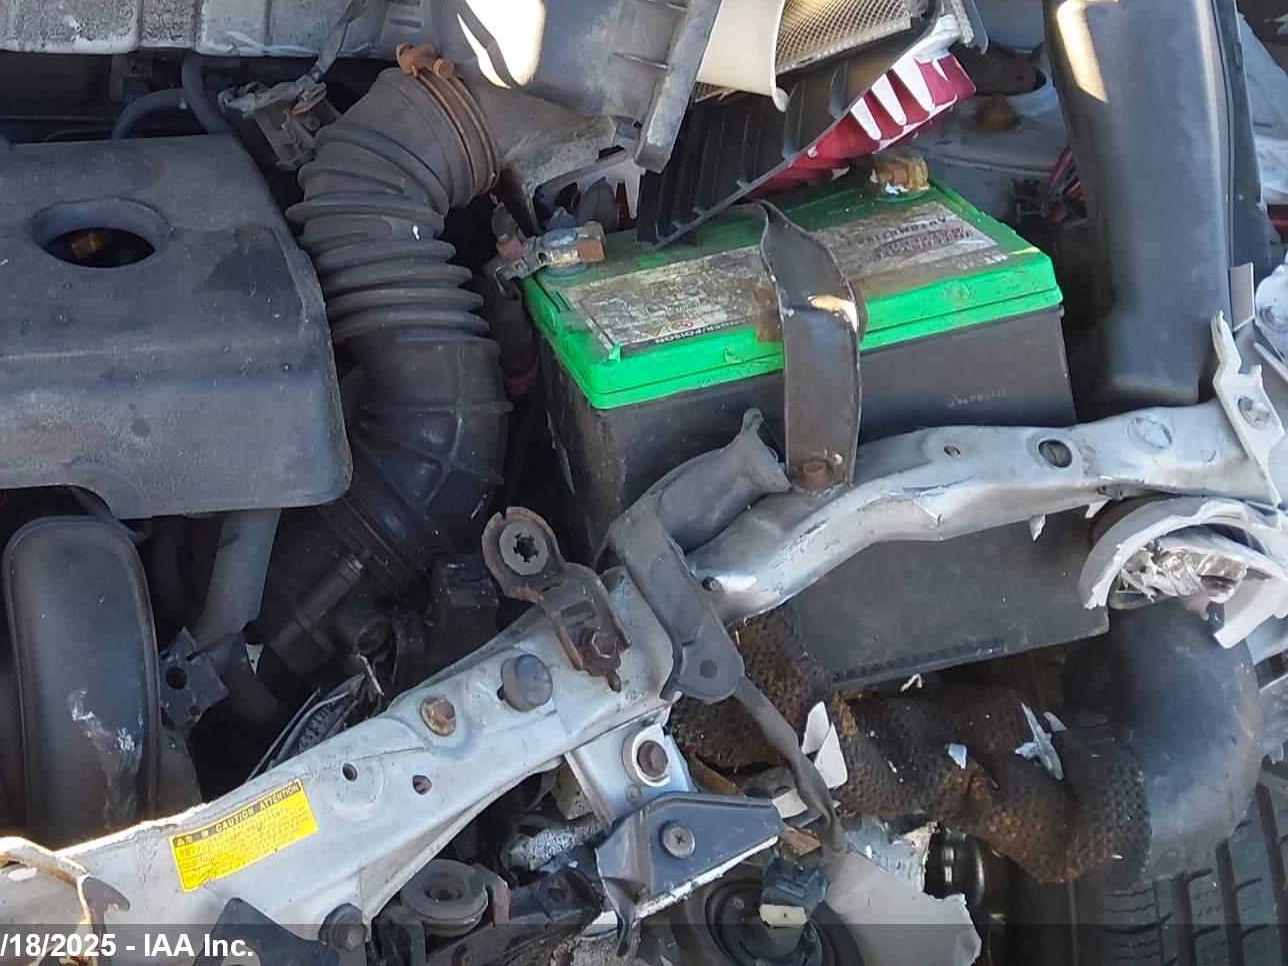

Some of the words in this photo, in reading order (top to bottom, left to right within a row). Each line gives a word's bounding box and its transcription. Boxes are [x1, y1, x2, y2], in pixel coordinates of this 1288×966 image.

[654, 318, 750, 345] ANGER/POISON
[215, 807, 255, 833] CAUTION
[259, 783, 300, 811] ATTENTION
